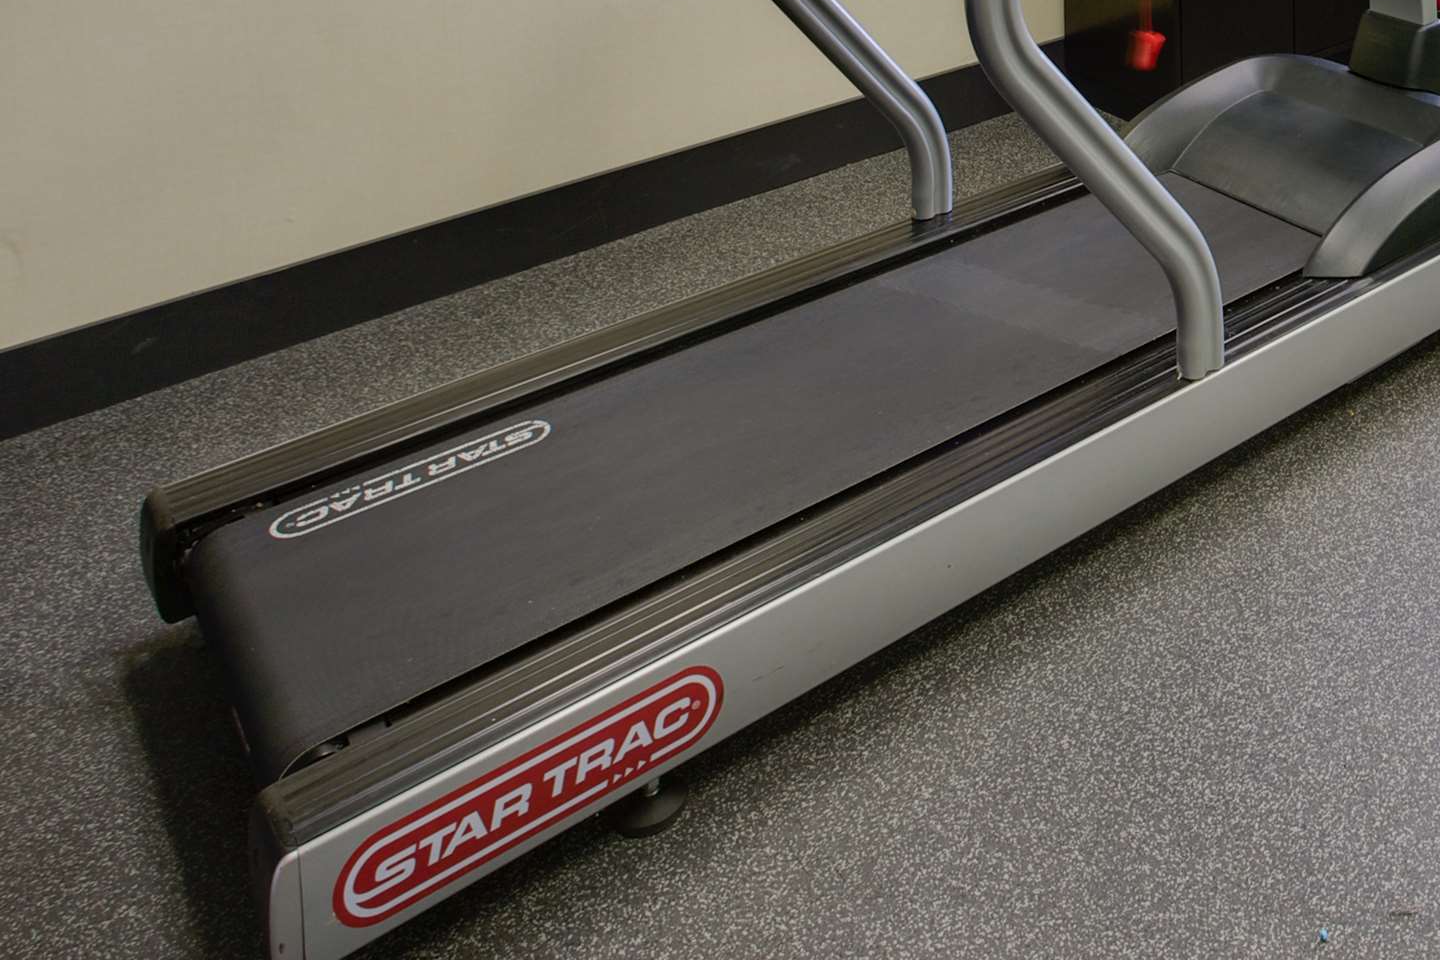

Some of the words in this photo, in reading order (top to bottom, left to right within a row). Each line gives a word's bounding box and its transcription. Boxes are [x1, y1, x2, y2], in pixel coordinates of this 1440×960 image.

[428, 430, 533, 476] STAR
[296, 472, 422, 527] TRAC
[373, 782, 533, 884] STAR
[543, 696, 692, 798] TRAC
